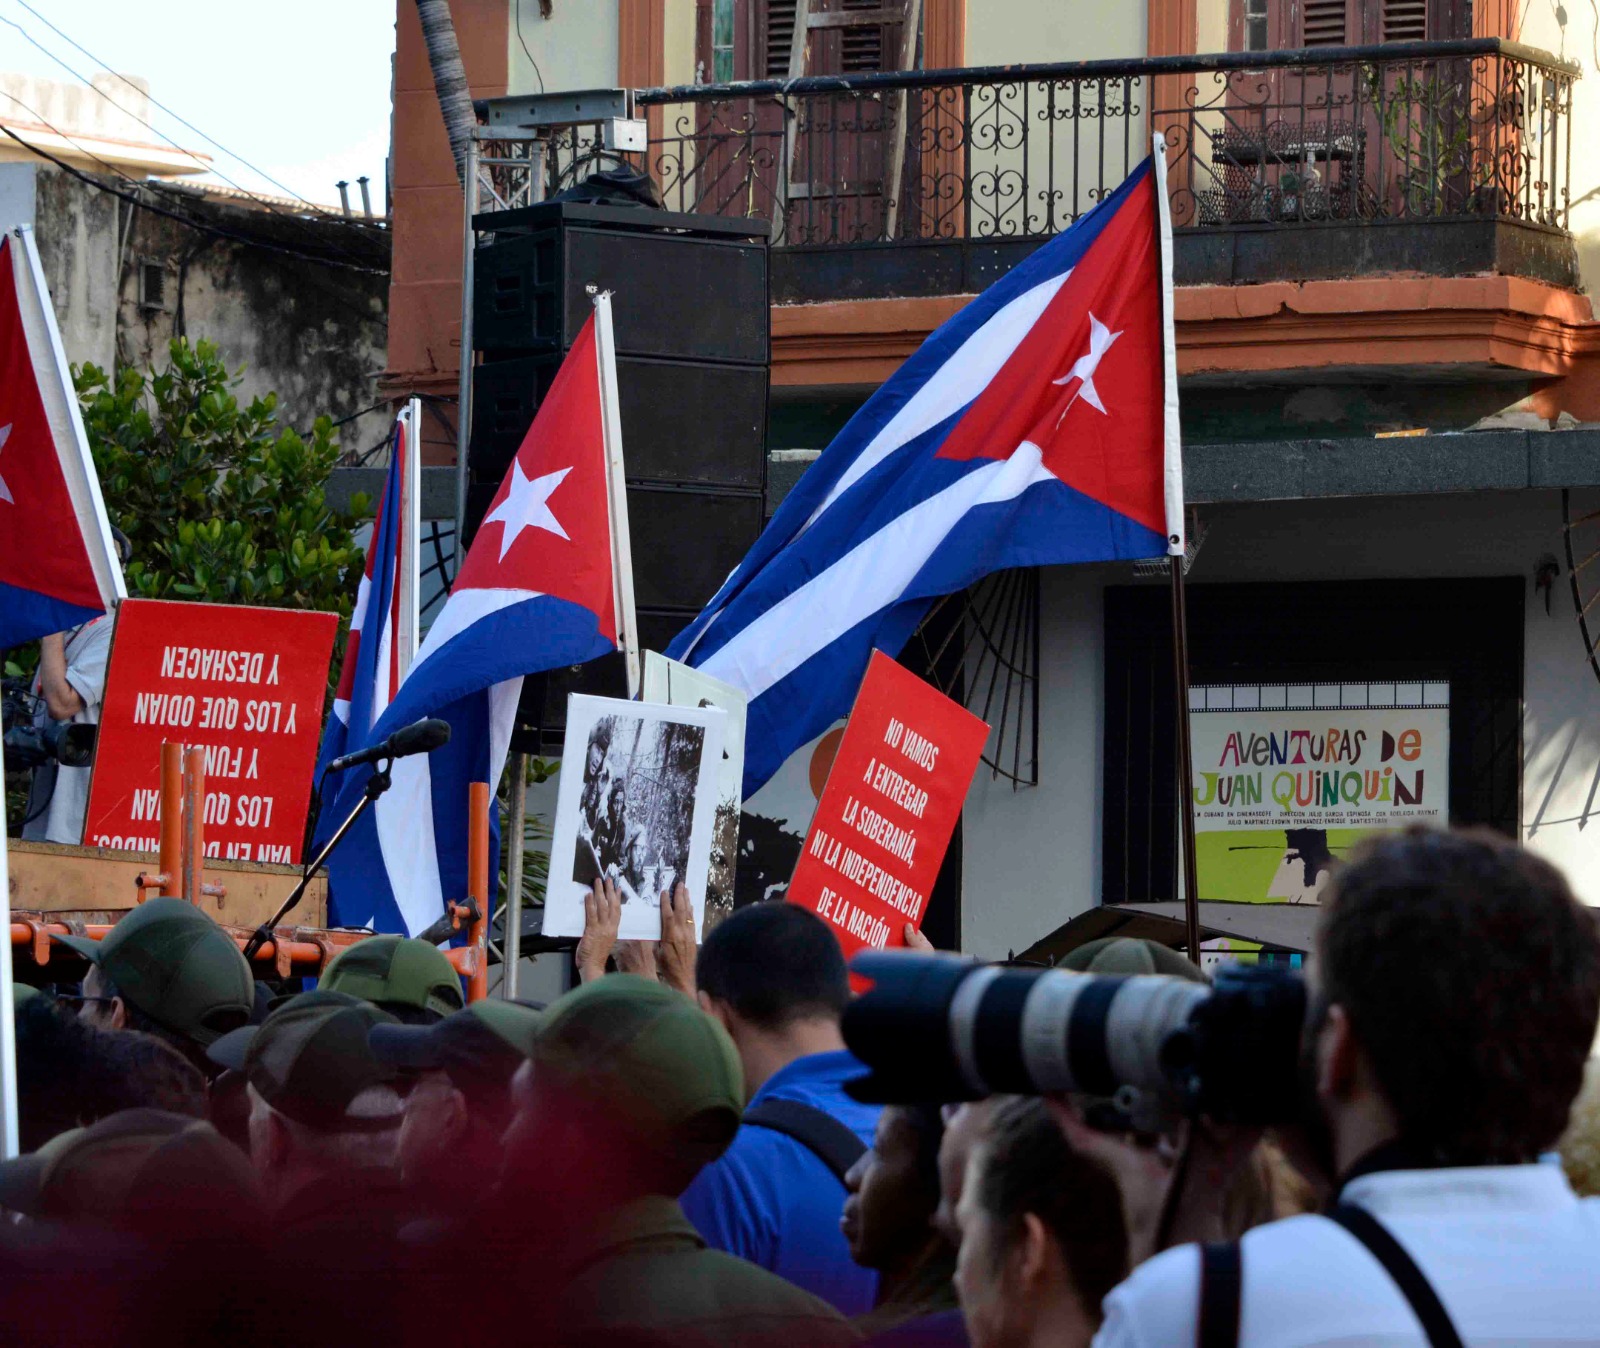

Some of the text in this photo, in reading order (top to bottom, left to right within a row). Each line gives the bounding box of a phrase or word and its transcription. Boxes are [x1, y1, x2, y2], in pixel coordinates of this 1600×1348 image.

[161, 646, 280, 685] Y DESHACEN
[134, 692, 297, 734] Y LOS QUE ODIAN
[246, 748, 258, 779] Y
[884, 717, 939, 772] NO VAMOS
[203, 792, 231, 825] QU
[863, 758, 929, 819] A ENTREGAR
[1192, 771, 1262, 808] JUAN
[235, 795, 273, 828] LOS
[841, 796, 917, 869] LA SOBERANÍA,
[809, 829, 923, 921] NI LA INDEPENDENCIA
[816, 886, 890, 950] DE LA NACIÓN
